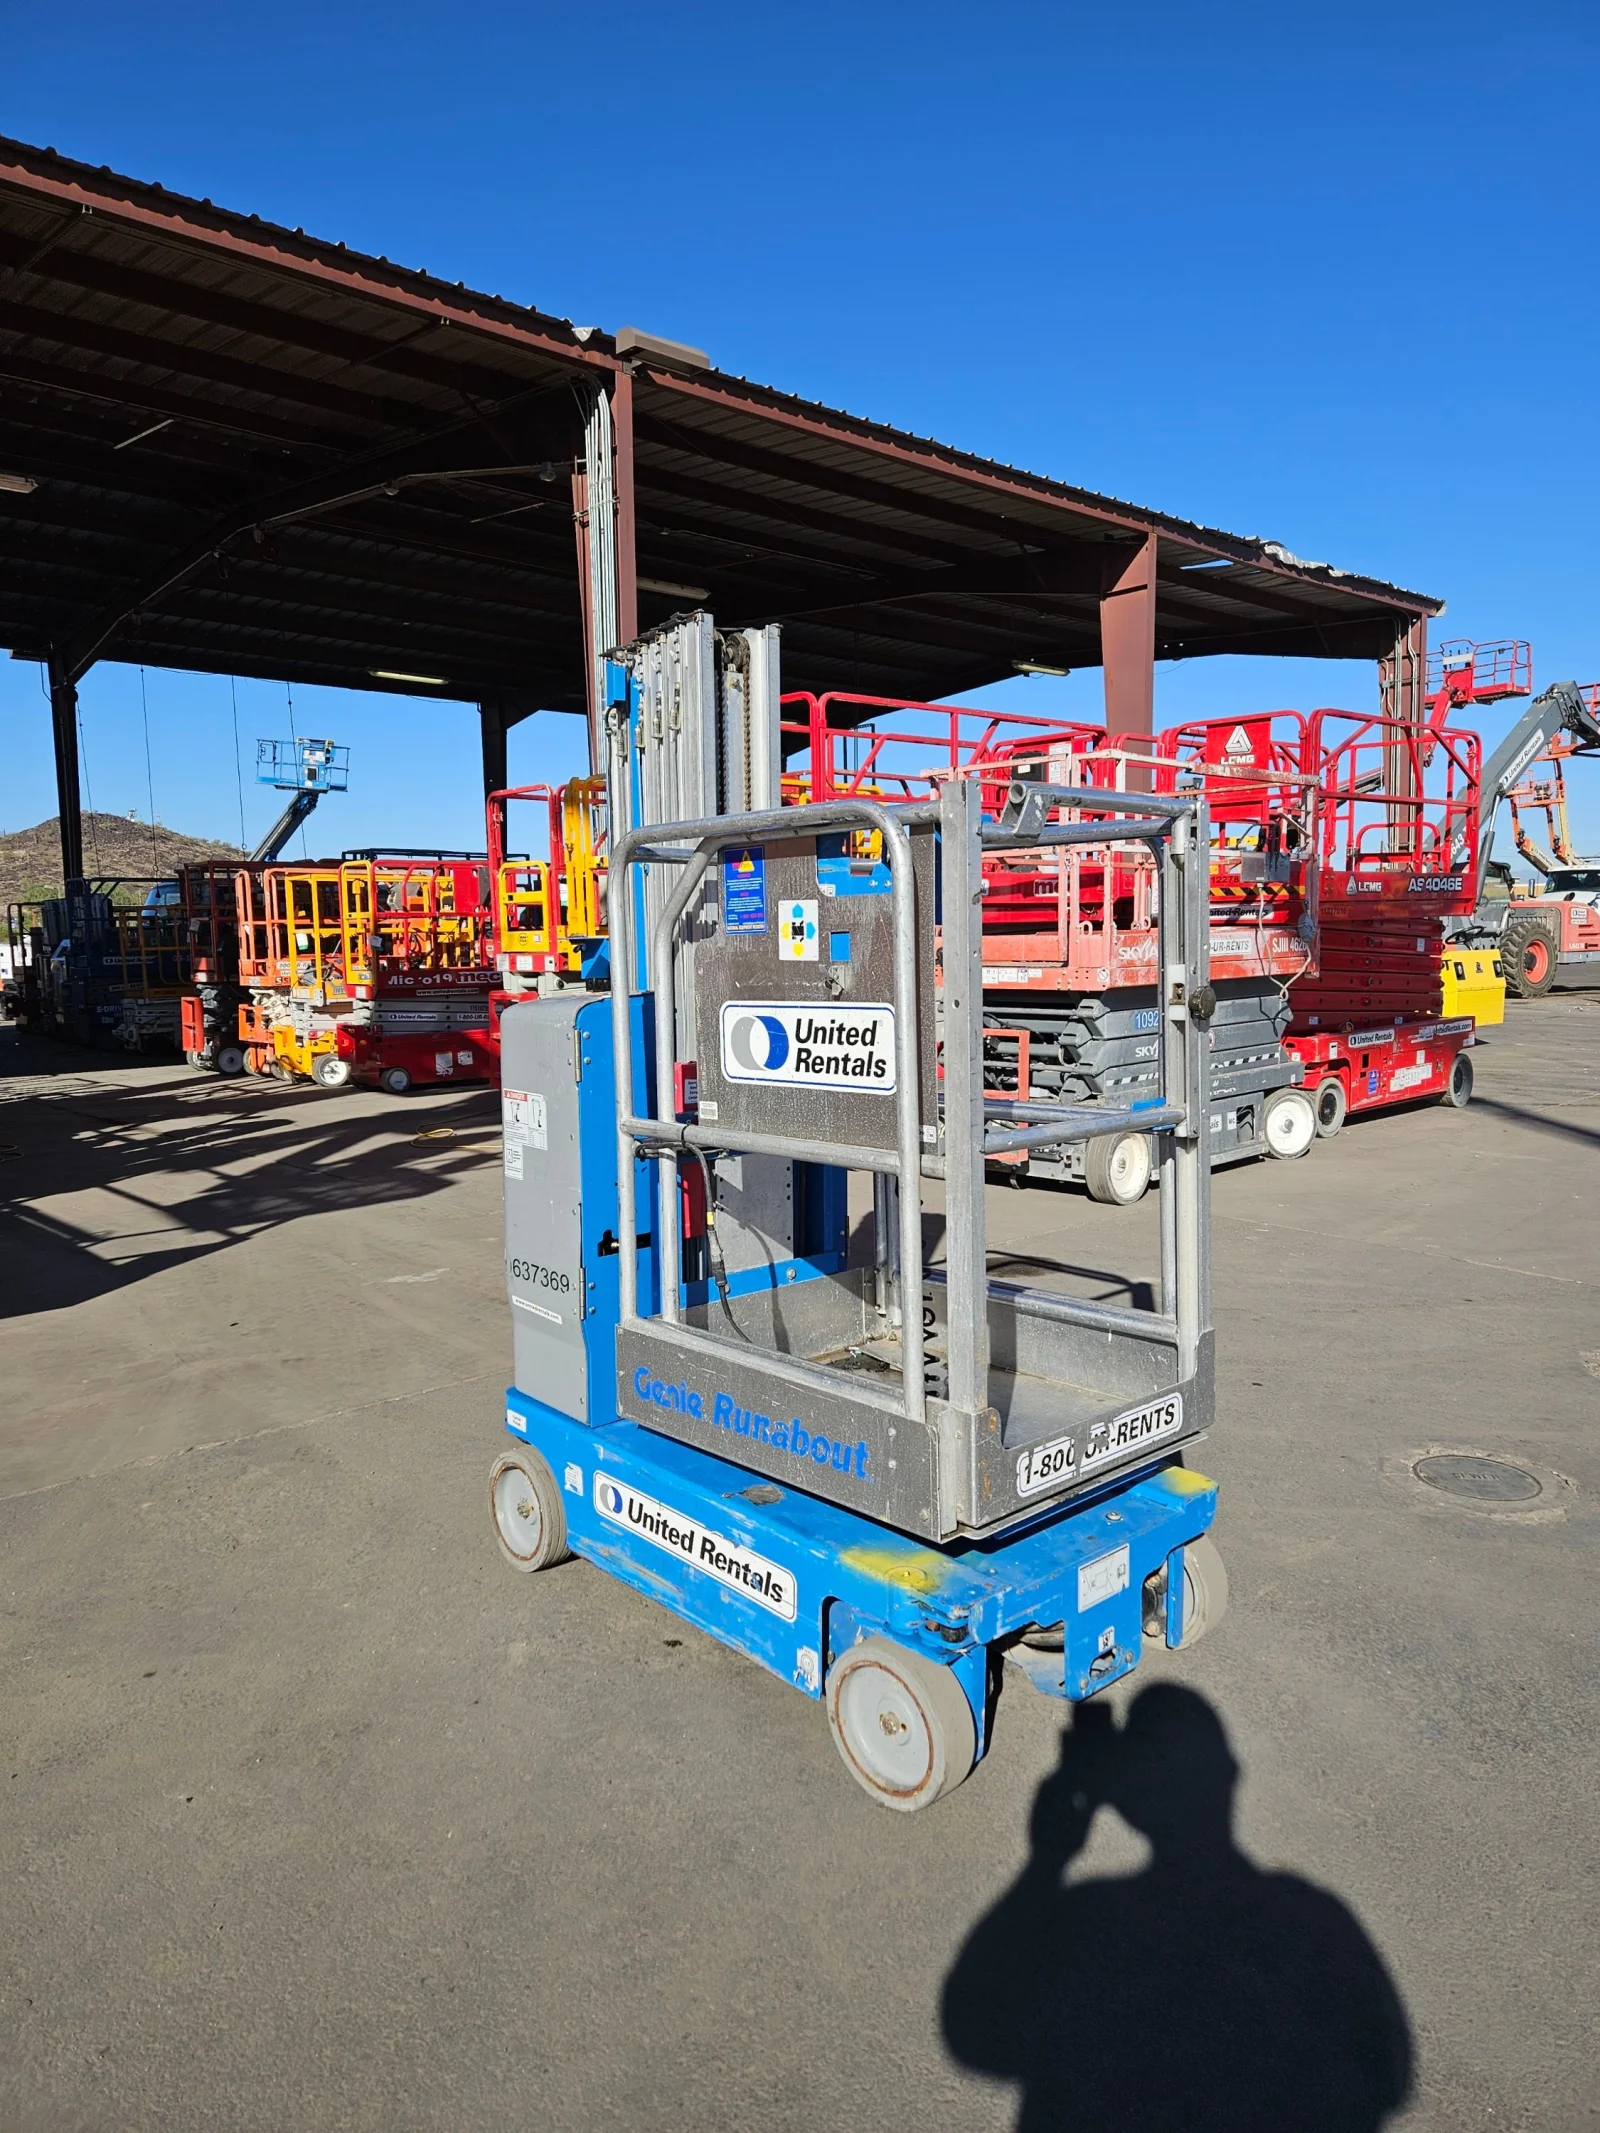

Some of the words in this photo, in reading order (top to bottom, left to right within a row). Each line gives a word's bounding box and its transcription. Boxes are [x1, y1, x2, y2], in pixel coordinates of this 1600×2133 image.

[1210, 875, 1240, 884] 12278
[1210, 908, 1233, 917] nited
[1233, 907, 1269, 917] Rentas
[1118, 938, 1158, 961] SKYJA
[1211, 940, 1250, 952] -UR-RENTS
[456, 971, 501, 983] mec
[97, 1005, 122, 1013] E-DRIV
[1135, 1011, 1159, 1028] 1092
[795, 1018, 878, 1047] United
[1357, 1033, 1374, 1044] United
[1375, 1031, 1393, 1042] Rentals
[795, 1047, 887, 1078] Rentals
[510, 1258, 570, 1294] 637369
[633, 1366, 703, 1420] Genie
[713, 1391, 870, 1480] Runabout
[628, 1498, 695, 1554] United
[700, 1536, 784, 1603] Rentals
